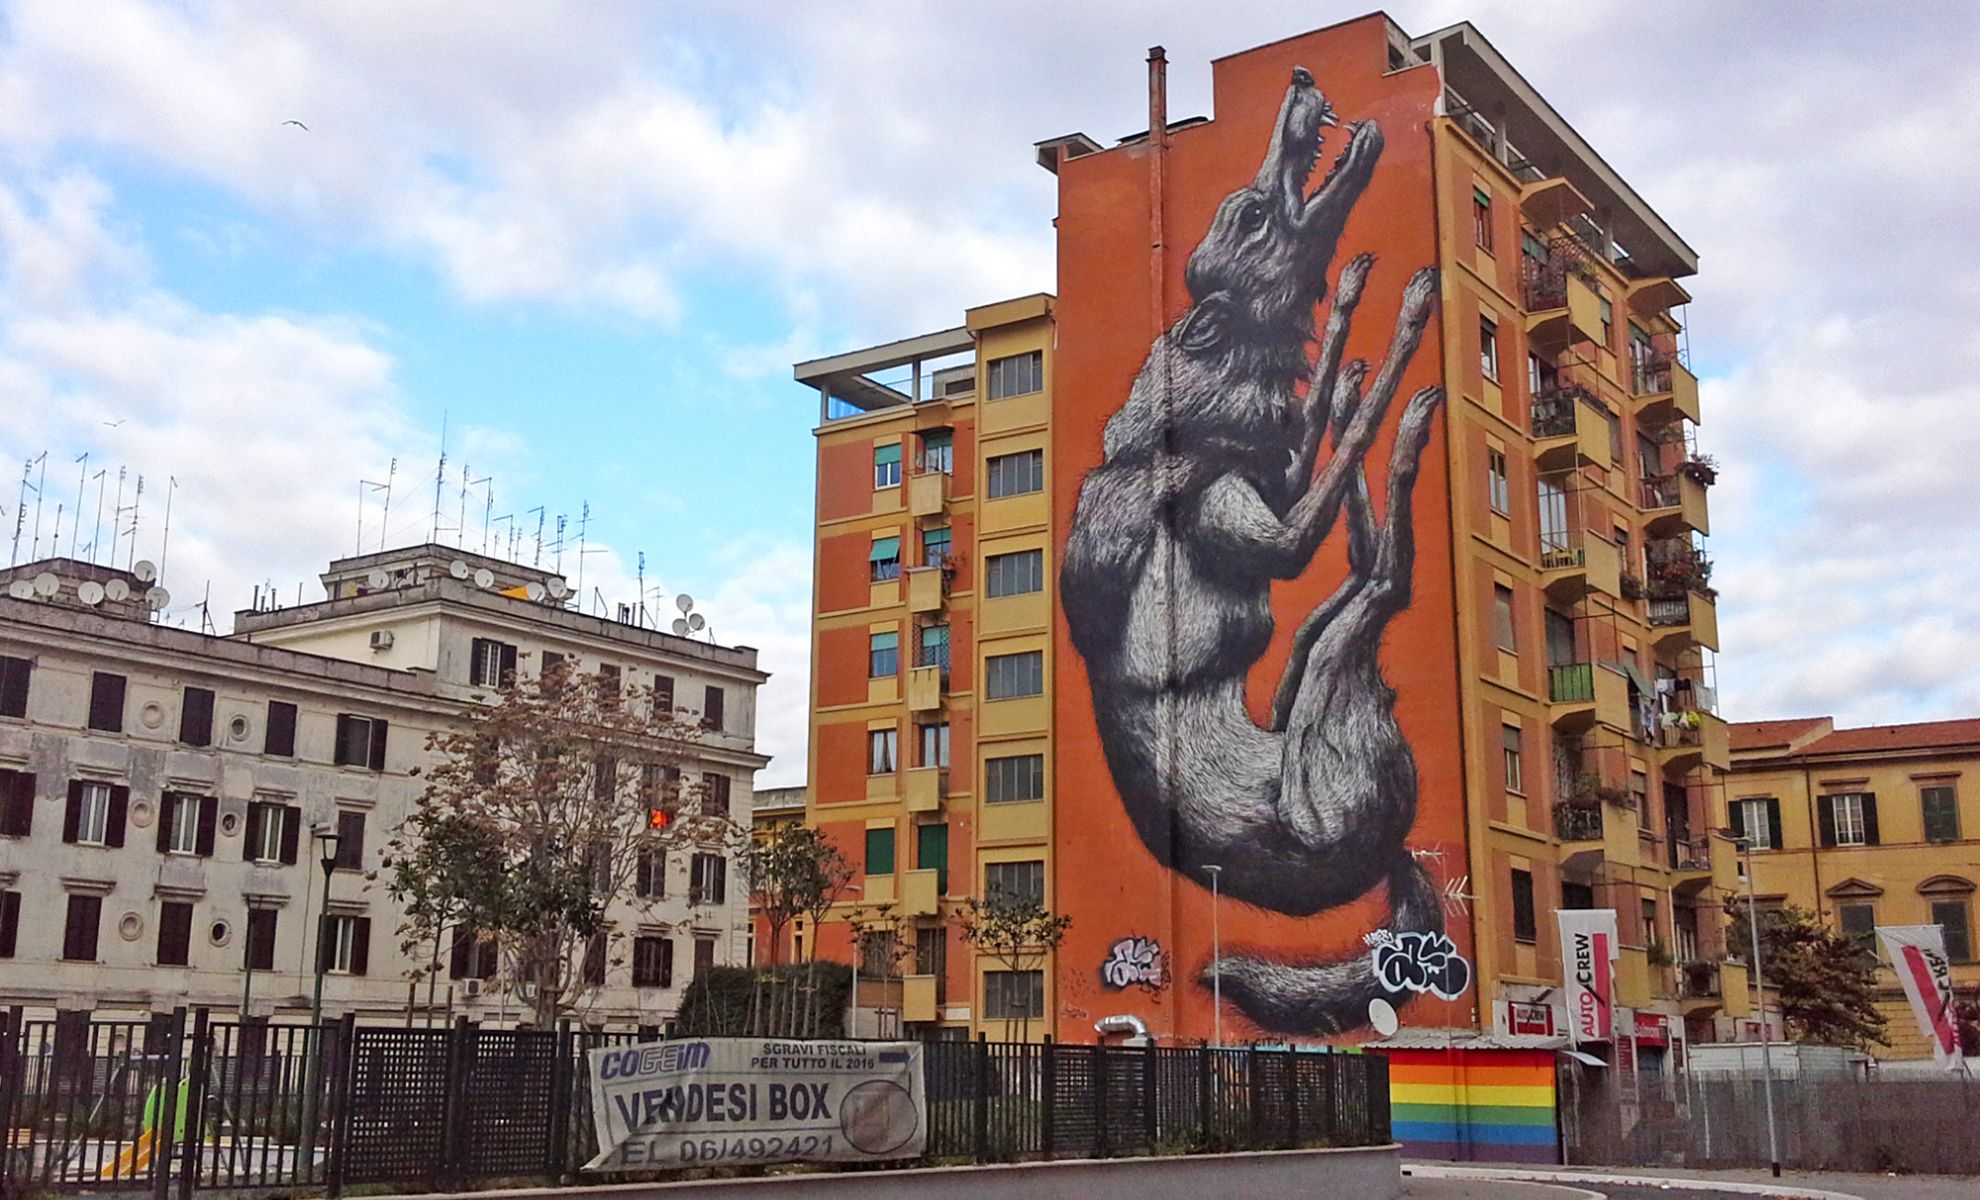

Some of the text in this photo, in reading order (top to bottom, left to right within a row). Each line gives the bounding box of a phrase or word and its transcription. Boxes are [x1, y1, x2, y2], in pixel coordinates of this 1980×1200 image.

[763, 1043, 866, 1055] SGRAVI FISCALI
[751, 1057, 874, 1069] PER TUTTO IL 2016
[615, 1083, 832, 1132] VENDESI BOX
[680, 1134, 834, 1162] 06/492421
